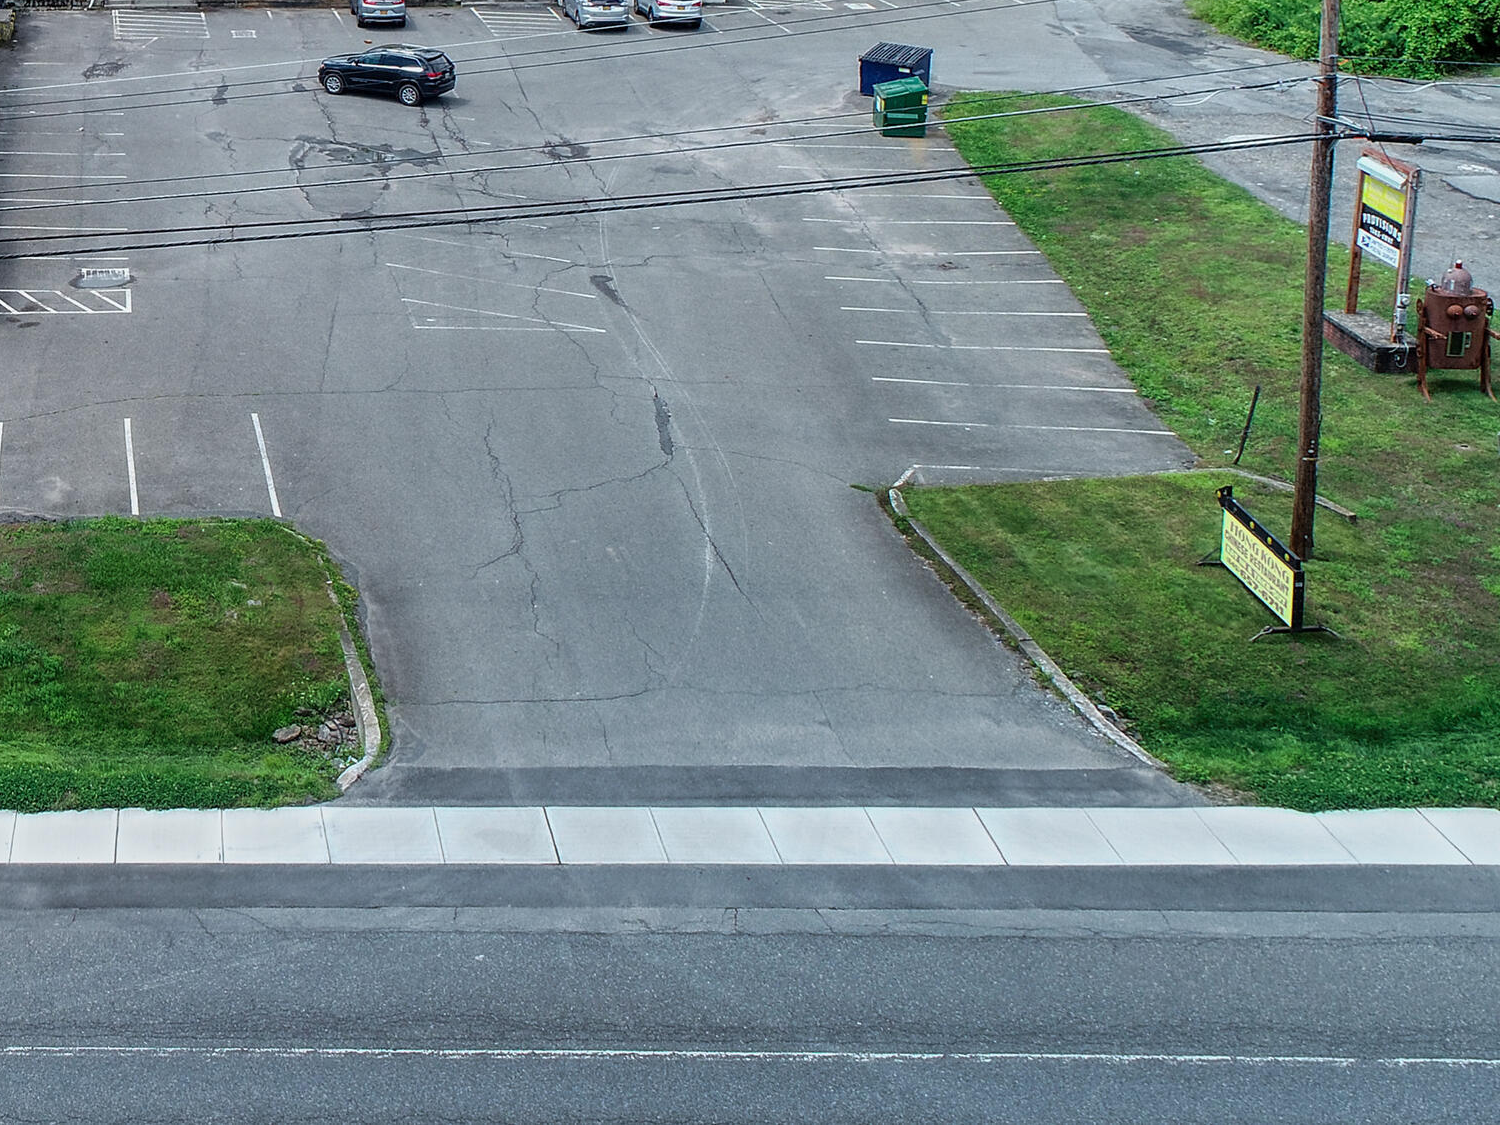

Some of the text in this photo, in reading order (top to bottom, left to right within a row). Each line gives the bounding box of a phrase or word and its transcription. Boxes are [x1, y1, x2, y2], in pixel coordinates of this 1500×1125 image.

[1363, 213, 1402, 242] PROVISIONS
[1230, 521, 1259, 556] HONG
[1260, 550, 1290, 583] KONG
